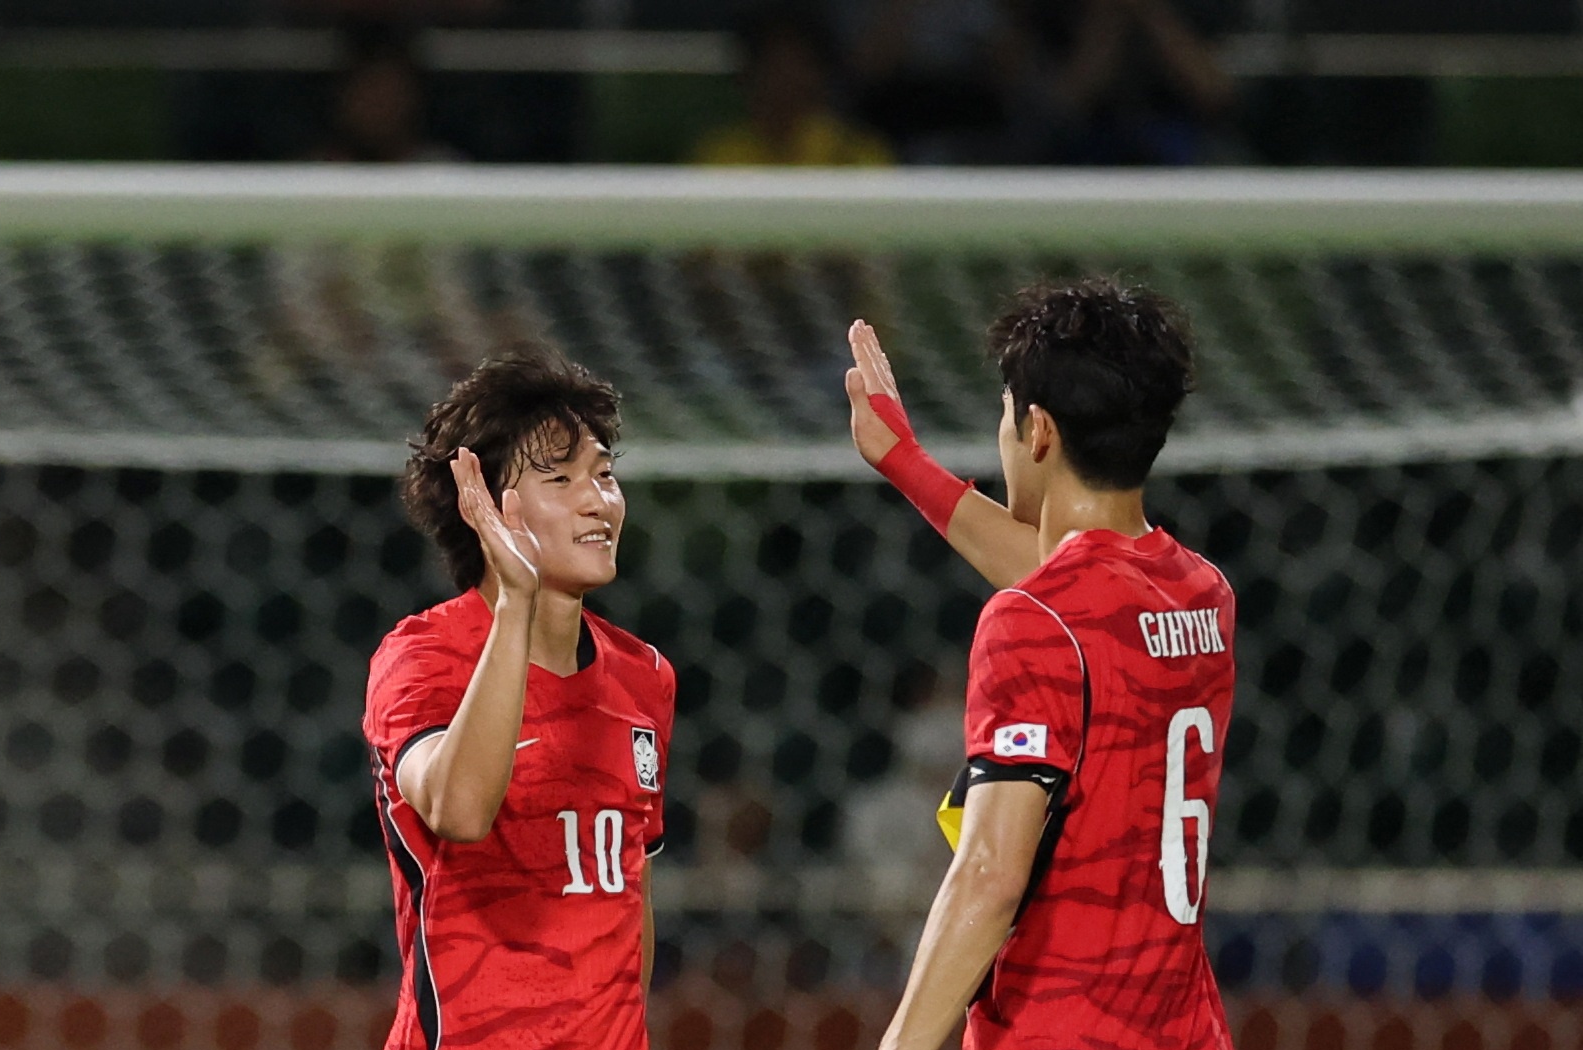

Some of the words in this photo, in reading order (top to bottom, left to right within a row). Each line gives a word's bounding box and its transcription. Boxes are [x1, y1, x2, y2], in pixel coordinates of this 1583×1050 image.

[1138, 607, 1226, 658] GIHYUK
[556, 809, 625, 896] 10
[1159, 706, 1214, 925] 6
